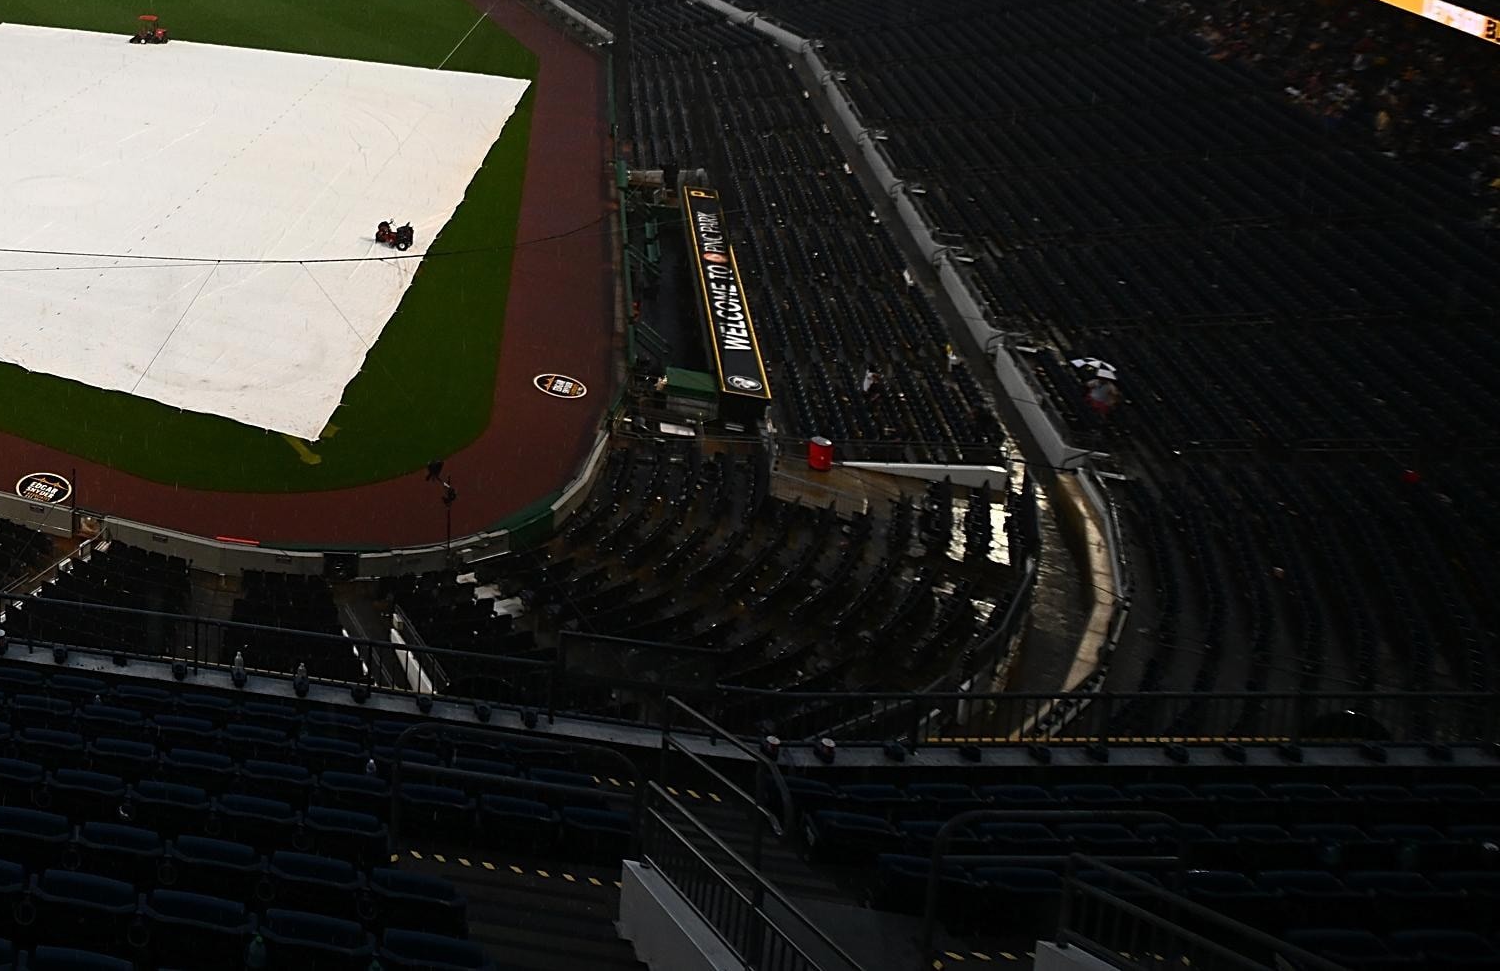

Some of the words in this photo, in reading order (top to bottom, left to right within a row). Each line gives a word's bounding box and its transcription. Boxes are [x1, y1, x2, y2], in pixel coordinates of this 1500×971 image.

[696, 210, 722, 233] PARK
[701, 233, 726, 253] PNC
[706, 265, 735, 281] TO
[710, 282, 752, 351] WELCOME
[25, 485, 55, 499] SNYDER
[29, 481, 59, 495] EDGAR
